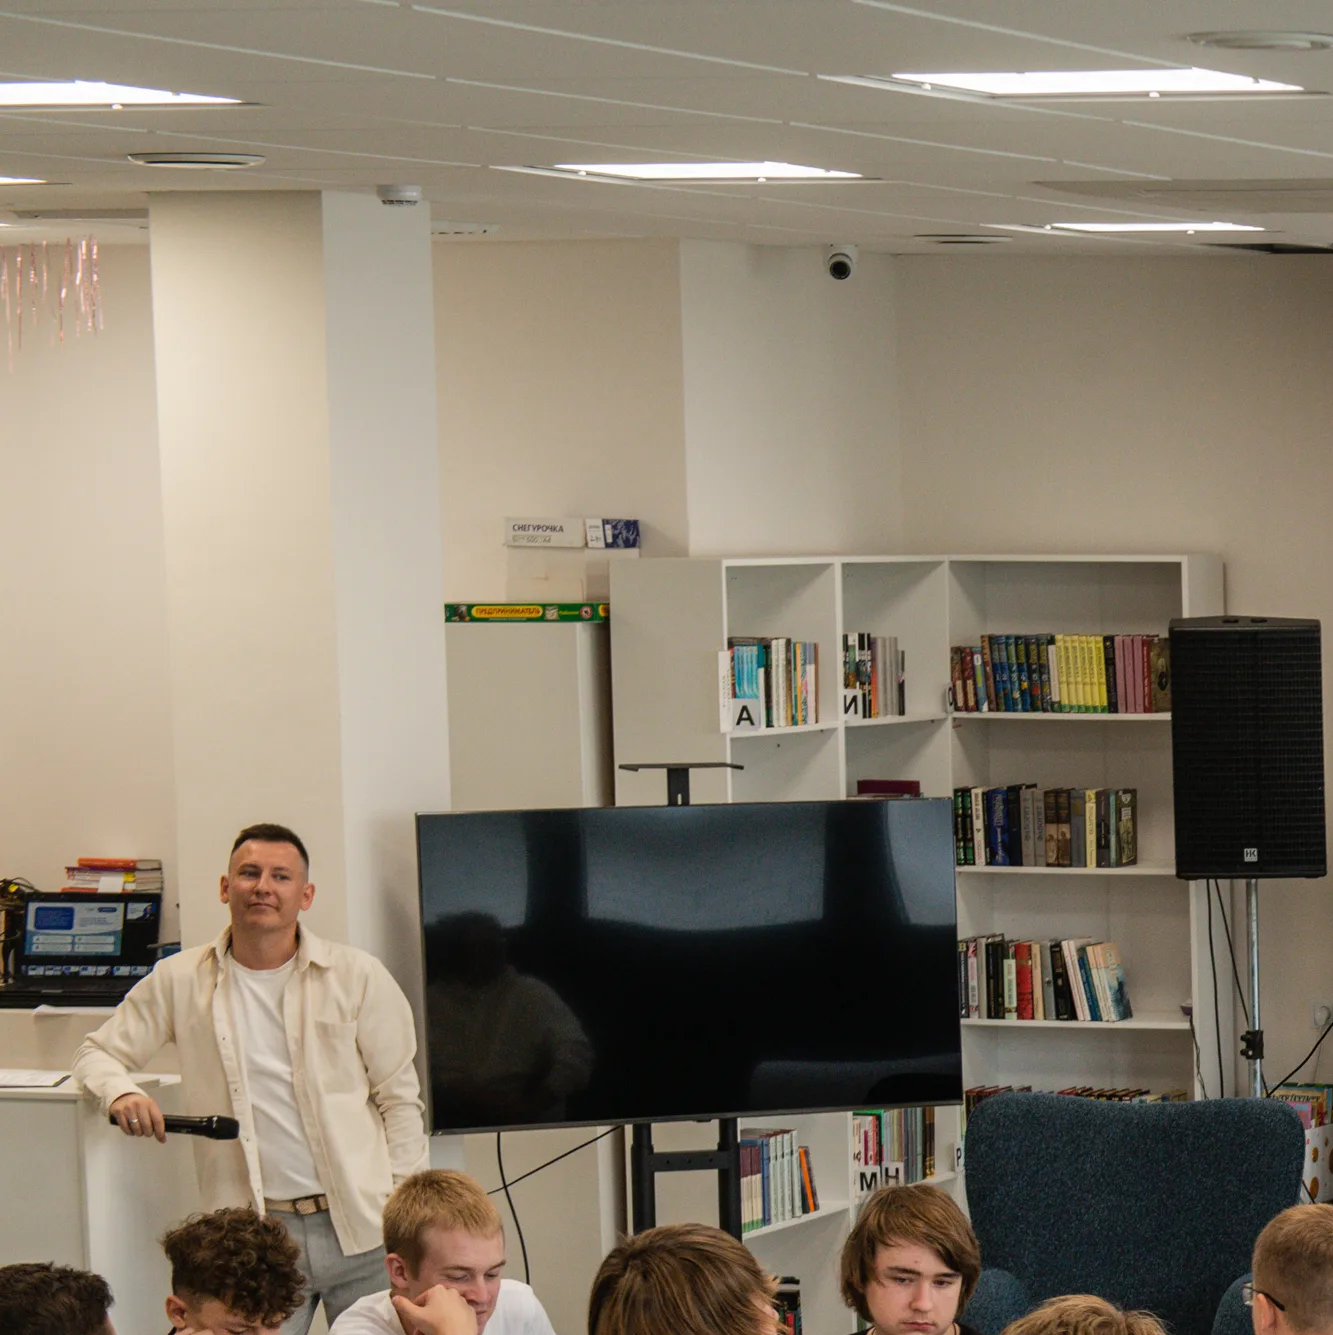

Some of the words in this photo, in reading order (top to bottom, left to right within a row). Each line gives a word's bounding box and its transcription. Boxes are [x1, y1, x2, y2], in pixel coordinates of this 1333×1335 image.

[512, 523, 564, 533] СНЕГУРОЧКА
[474, 607, 541, 616] ПРЕДПРИНИМАТЕЛЬ
[735, 704, 755, 726] А
[843, 694, 858, 715] И
[859, 1171, 878, 1192] М
[884, 1166, 900, 1186] Н
